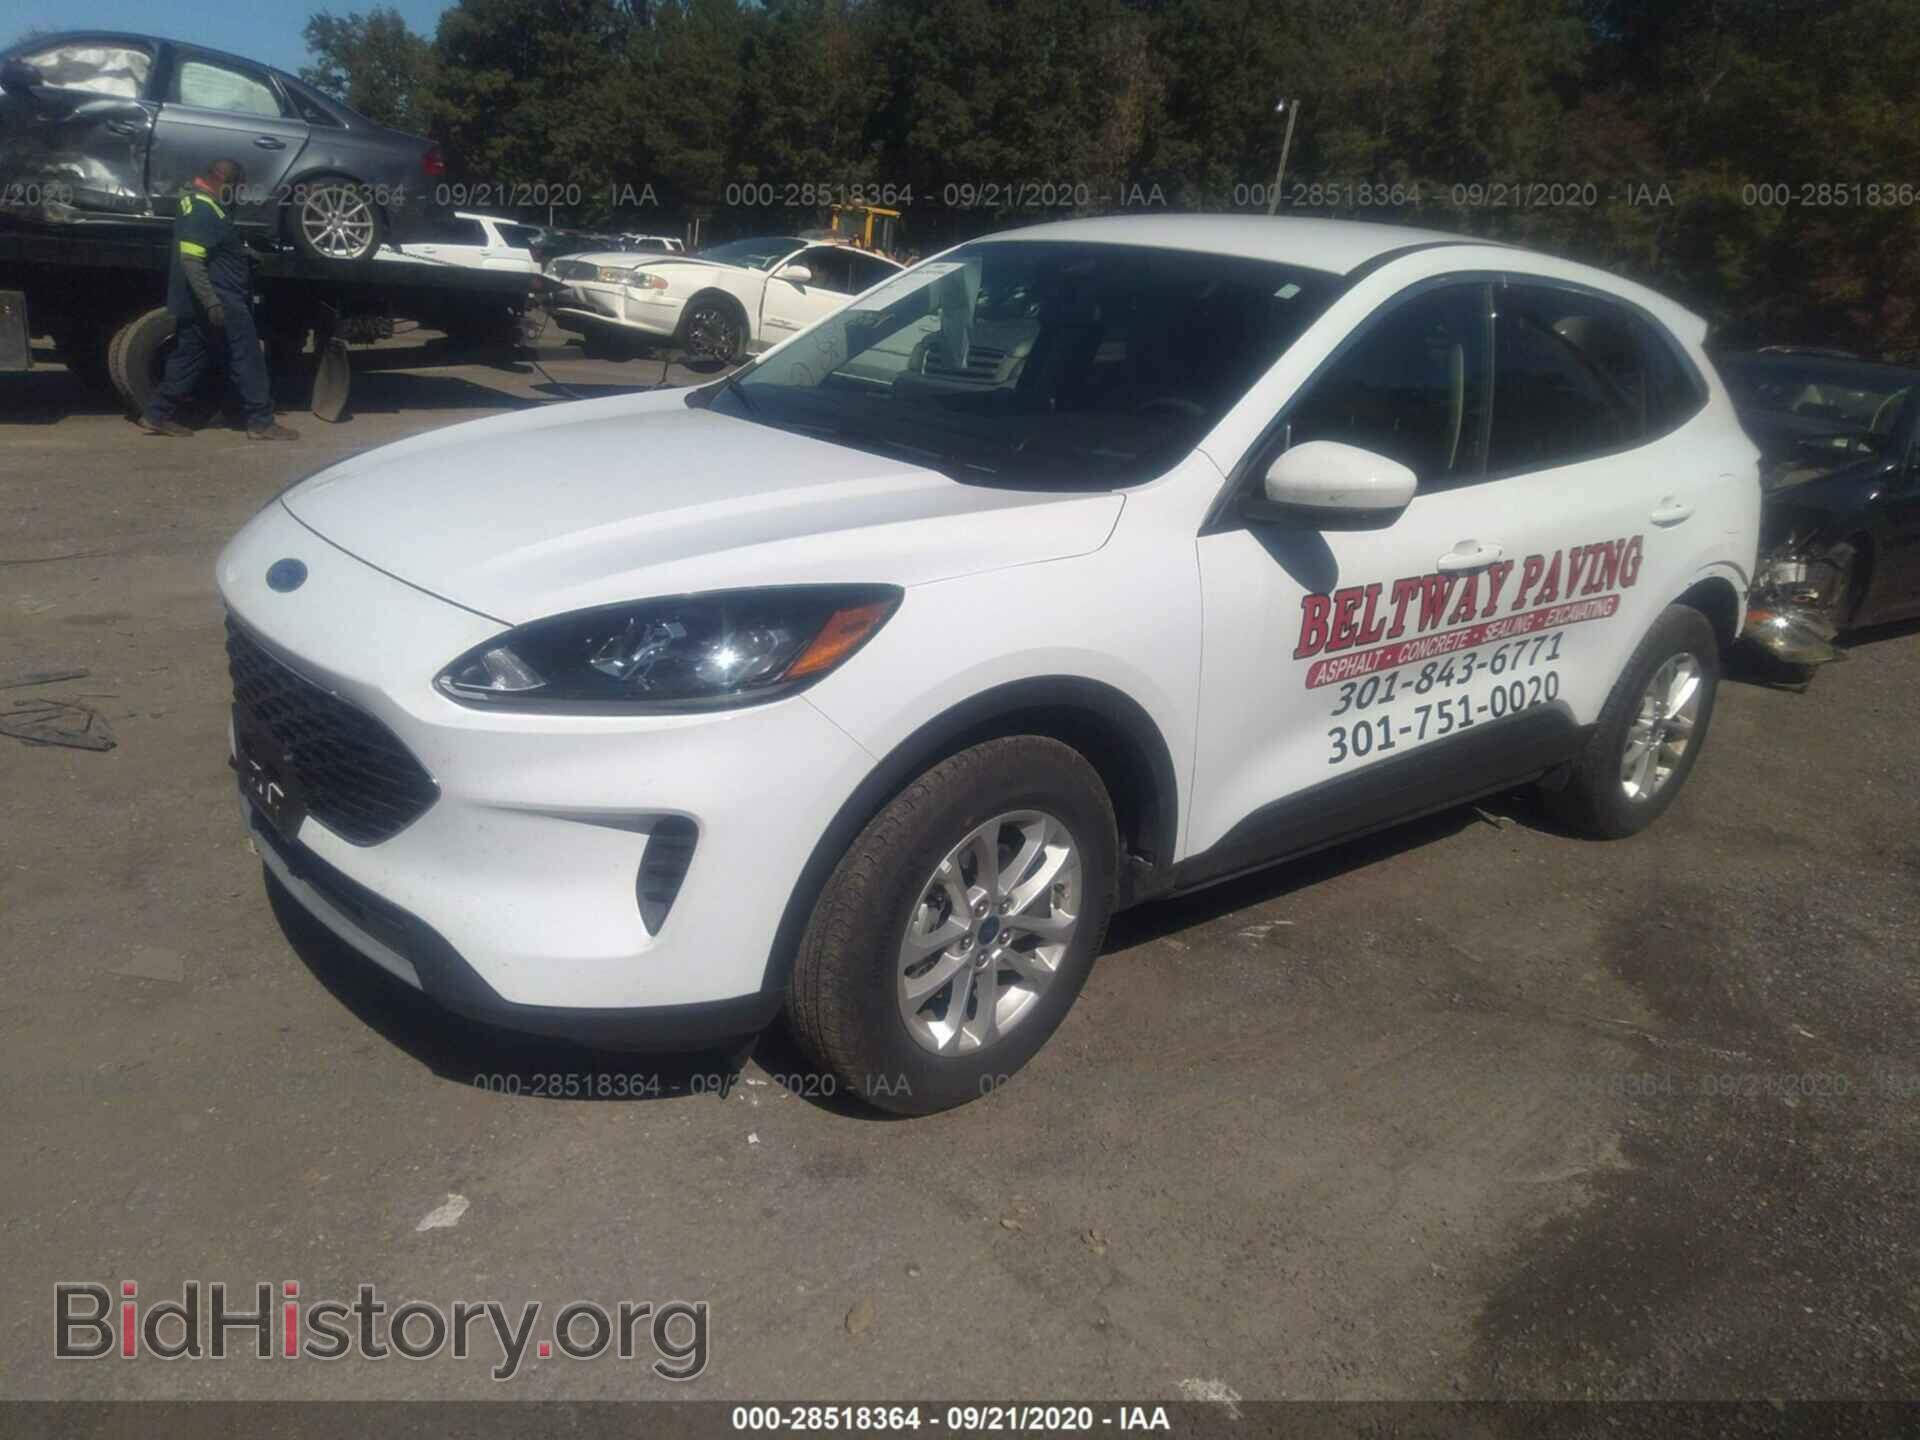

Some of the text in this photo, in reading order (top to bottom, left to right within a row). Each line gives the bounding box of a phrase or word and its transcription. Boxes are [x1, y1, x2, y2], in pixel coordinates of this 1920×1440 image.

[1293, 535, 1644, 660] BELTWAY PAVING
[1314, 650, 1385, 686] ASPHALT
[1398, 629, 1471, 664] CONCRETE
[1482, 614, 1535, 642] SEALING
[1331, 632, 1565, 716] 301-843-6771
[1328, 671, 1560, 764] 301-751-0020
